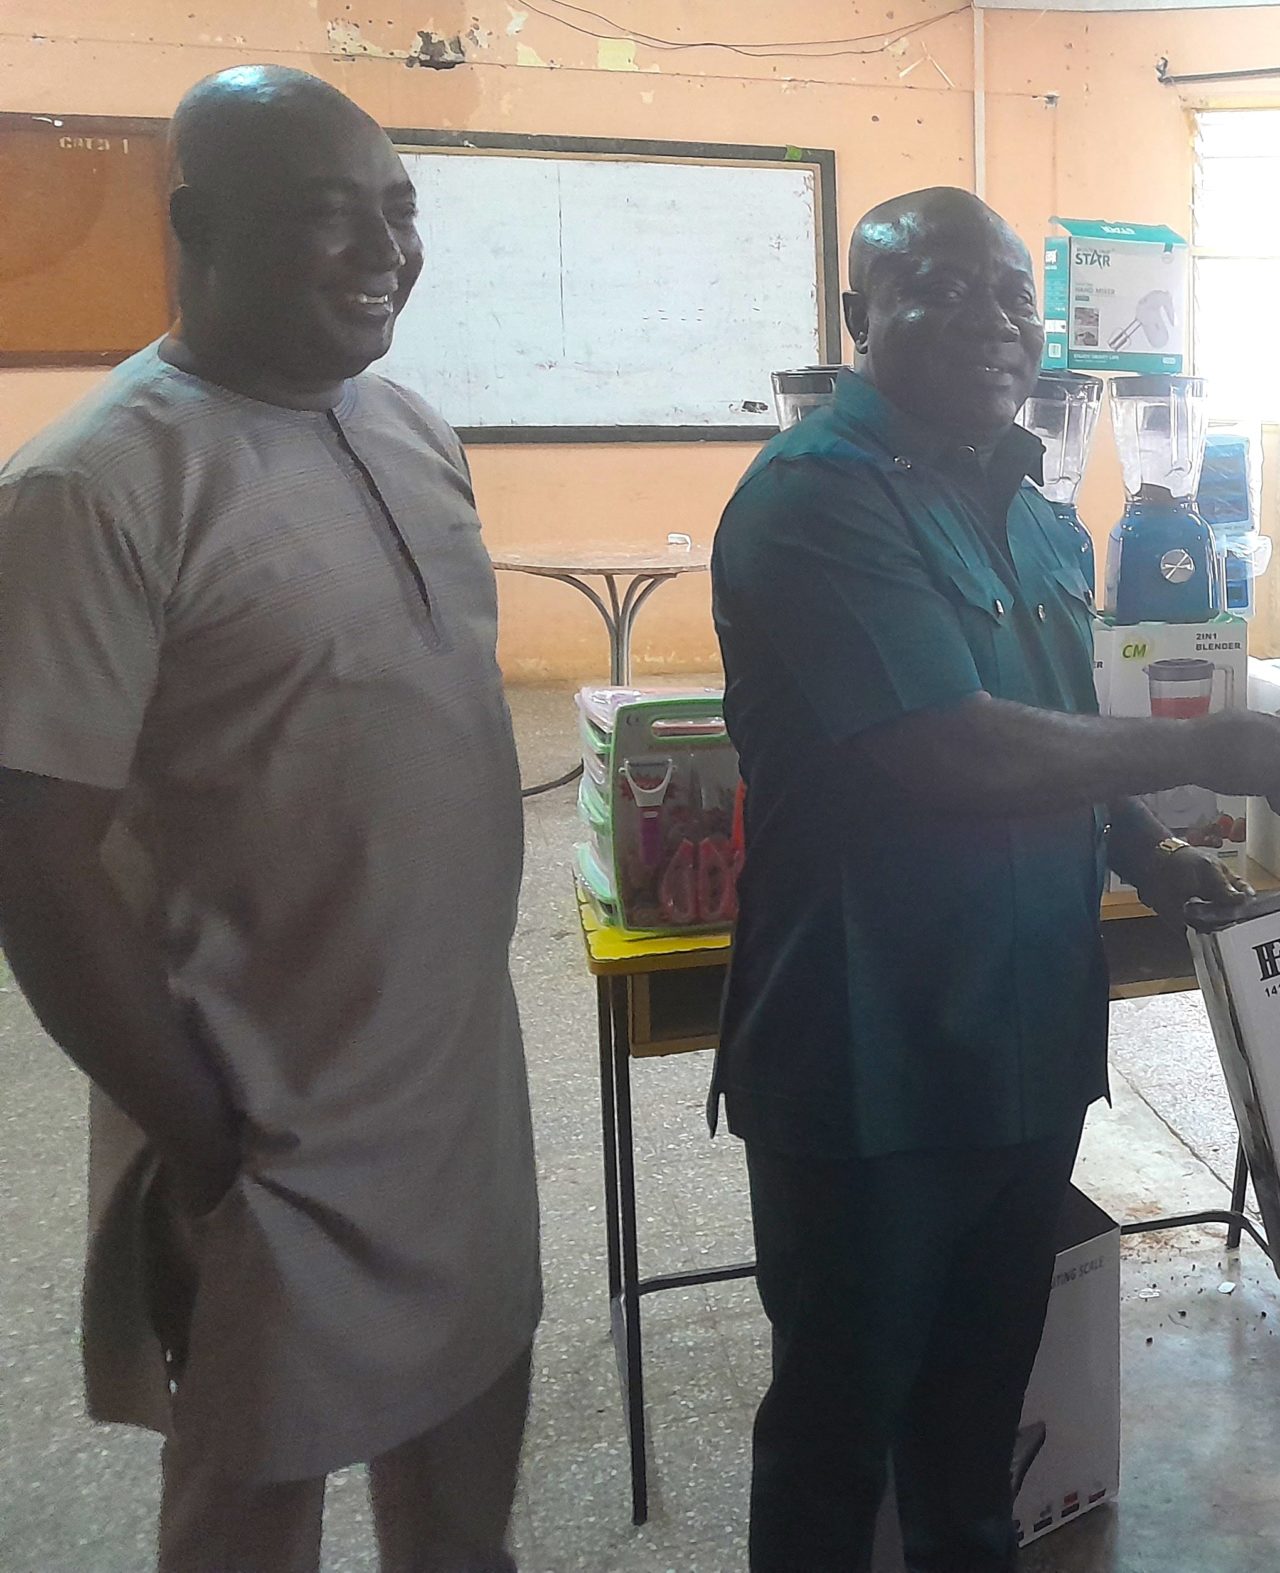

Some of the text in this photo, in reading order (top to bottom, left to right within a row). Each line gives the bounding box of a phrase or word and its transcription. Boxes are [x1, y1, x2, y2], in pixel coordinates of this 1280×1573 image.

[1075, 250, 1111, 270] STAR
[1196, 633, 1217, 641] 2IN1
[1122, 644, 1147, 658] CM
[1195, 642, 1241, 651] BLENDER
